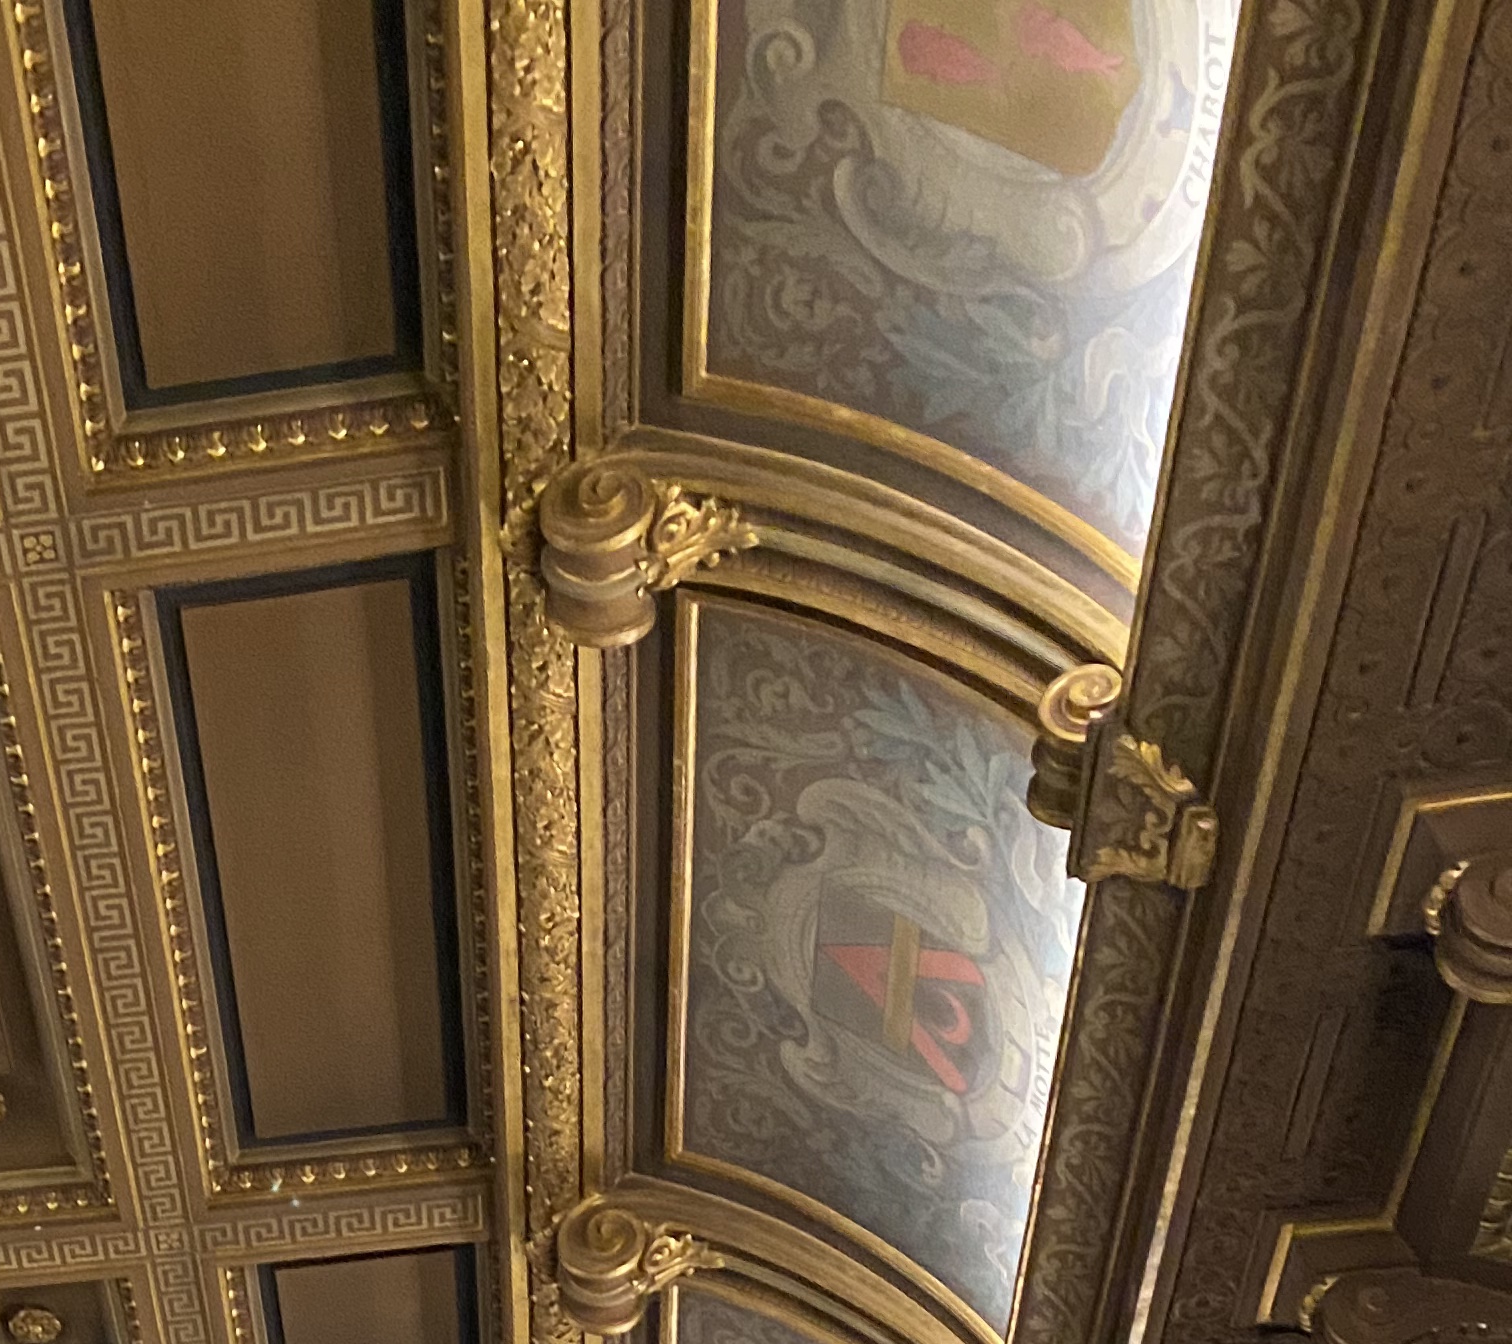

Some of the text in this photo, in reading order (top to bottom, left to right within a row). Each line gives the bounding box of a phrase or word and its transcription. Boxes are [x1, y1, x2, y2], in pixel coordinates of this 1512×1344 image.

[1181, 20, 1226, 209] CHABOT
[1014, 1022, 1052, 1149] LA MOTTE
